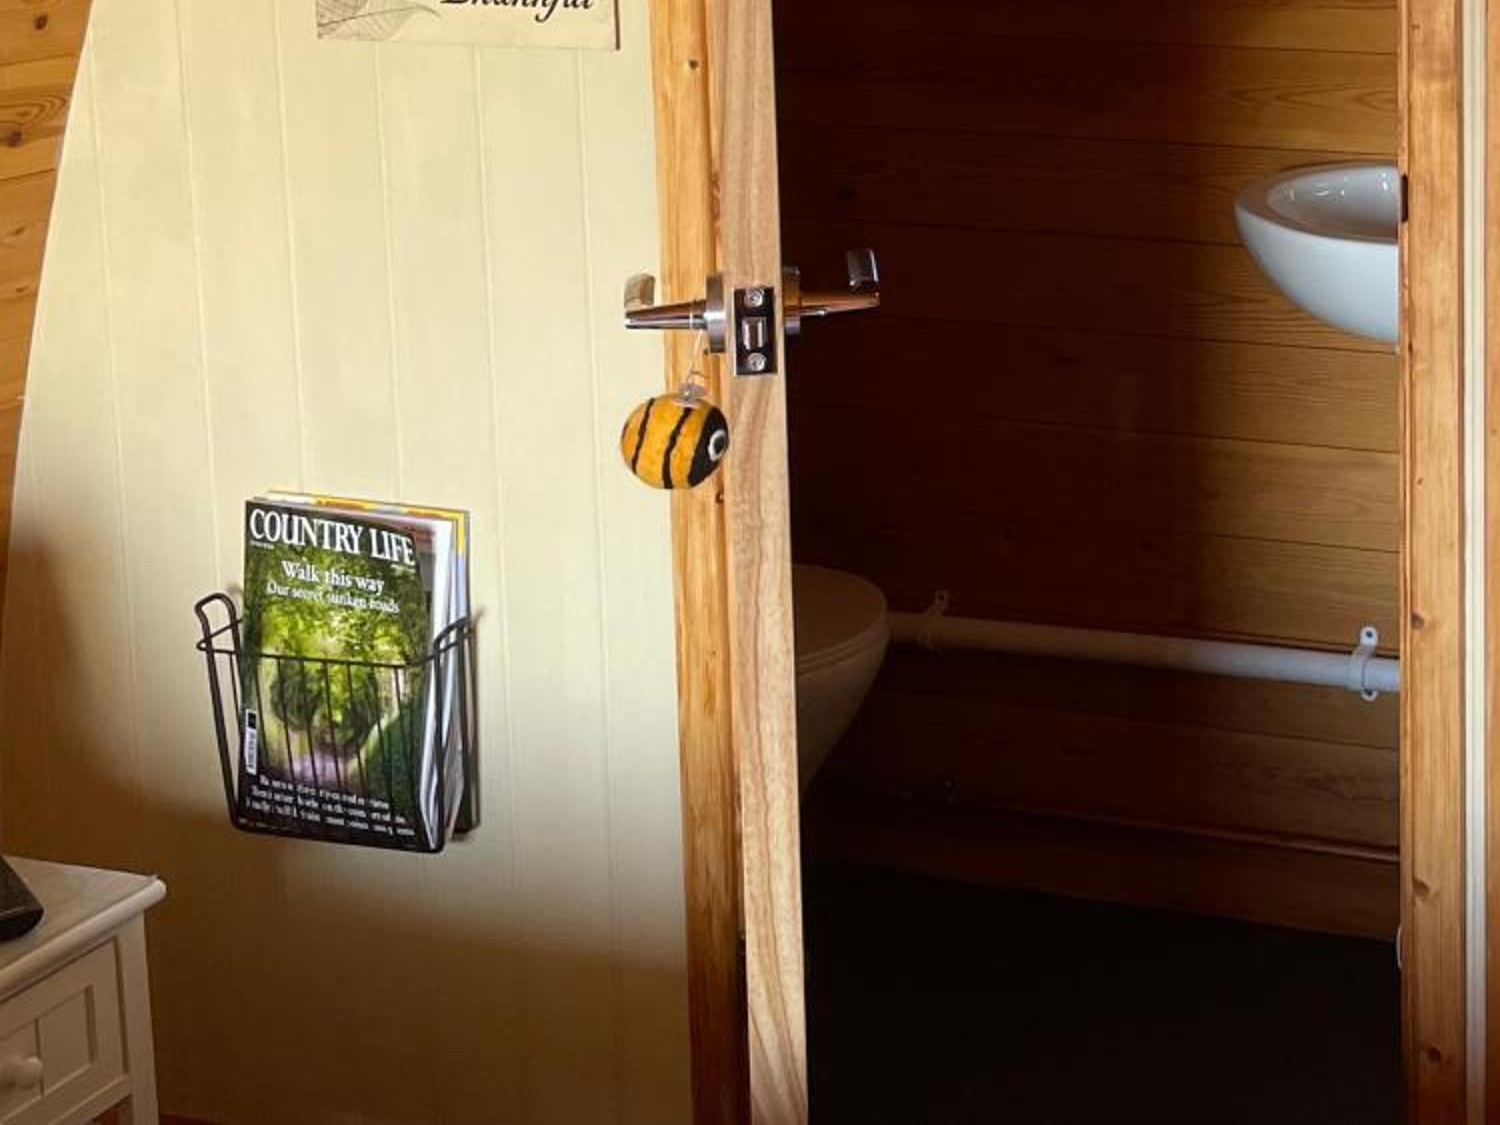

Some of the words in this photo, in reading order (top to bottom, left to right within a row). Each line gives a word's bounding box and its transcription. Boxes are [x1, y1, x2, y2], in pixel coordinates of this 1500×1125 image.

[250, 508, 363, 555] COUNTRY
[369, 528, 417, 566] LIFE
[266, 580, 290, 596] Our
[281, 559, 319, 583] Walk
[325, 567, 353, 588] this
[355, 575, 385, 596] way
